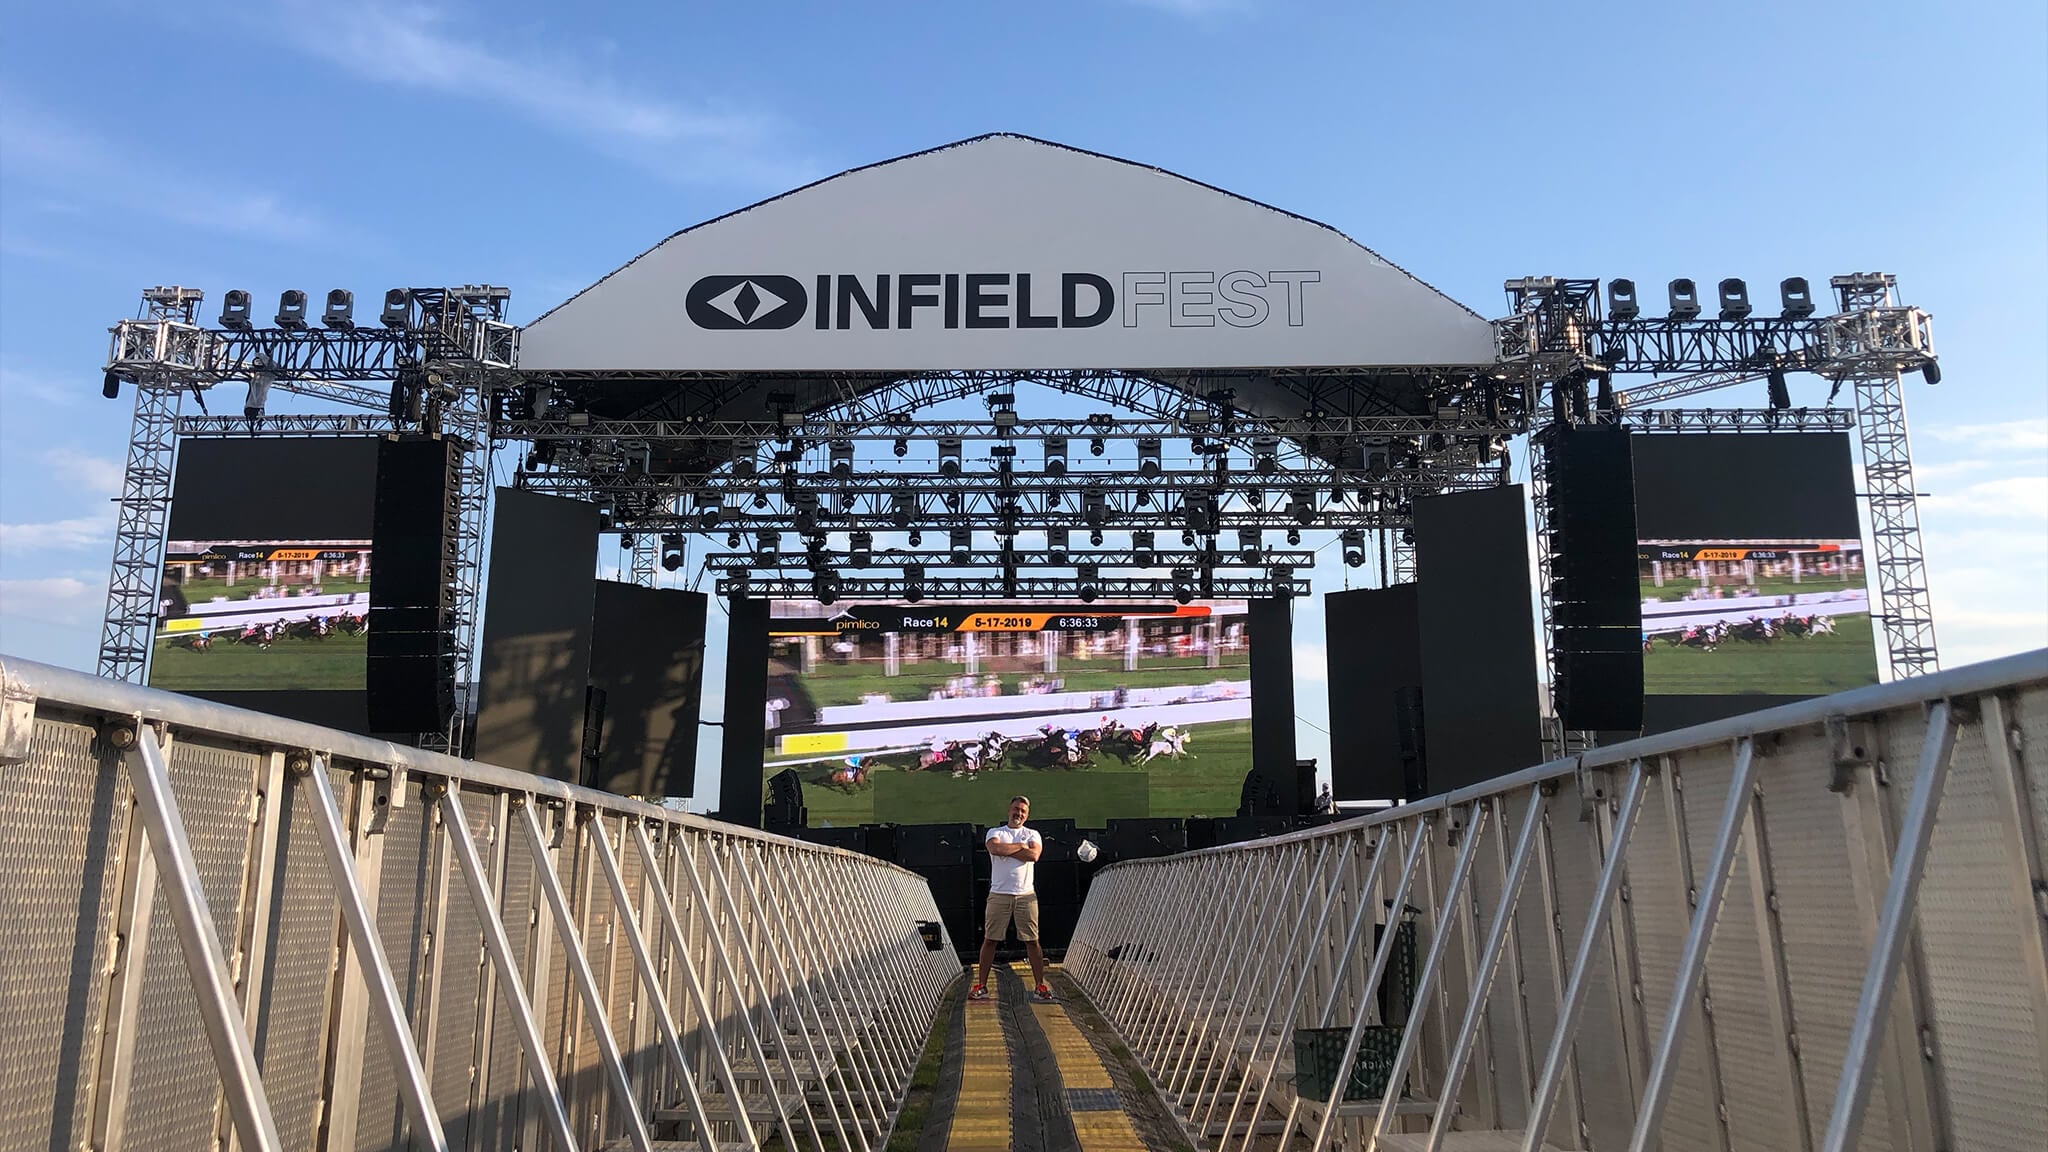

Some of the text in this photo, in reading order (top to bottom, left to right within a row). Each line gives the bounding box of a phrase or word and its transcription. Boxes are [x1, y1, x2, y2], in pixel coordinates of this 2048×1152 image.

[836, 618, 880, 631] pimlico
[974, 617, 1032, 628] 5-17-2019
[1058, 617, 1099, 628] 6:36:33
[1353, 1059, 1393, 1070] ARDIAN
